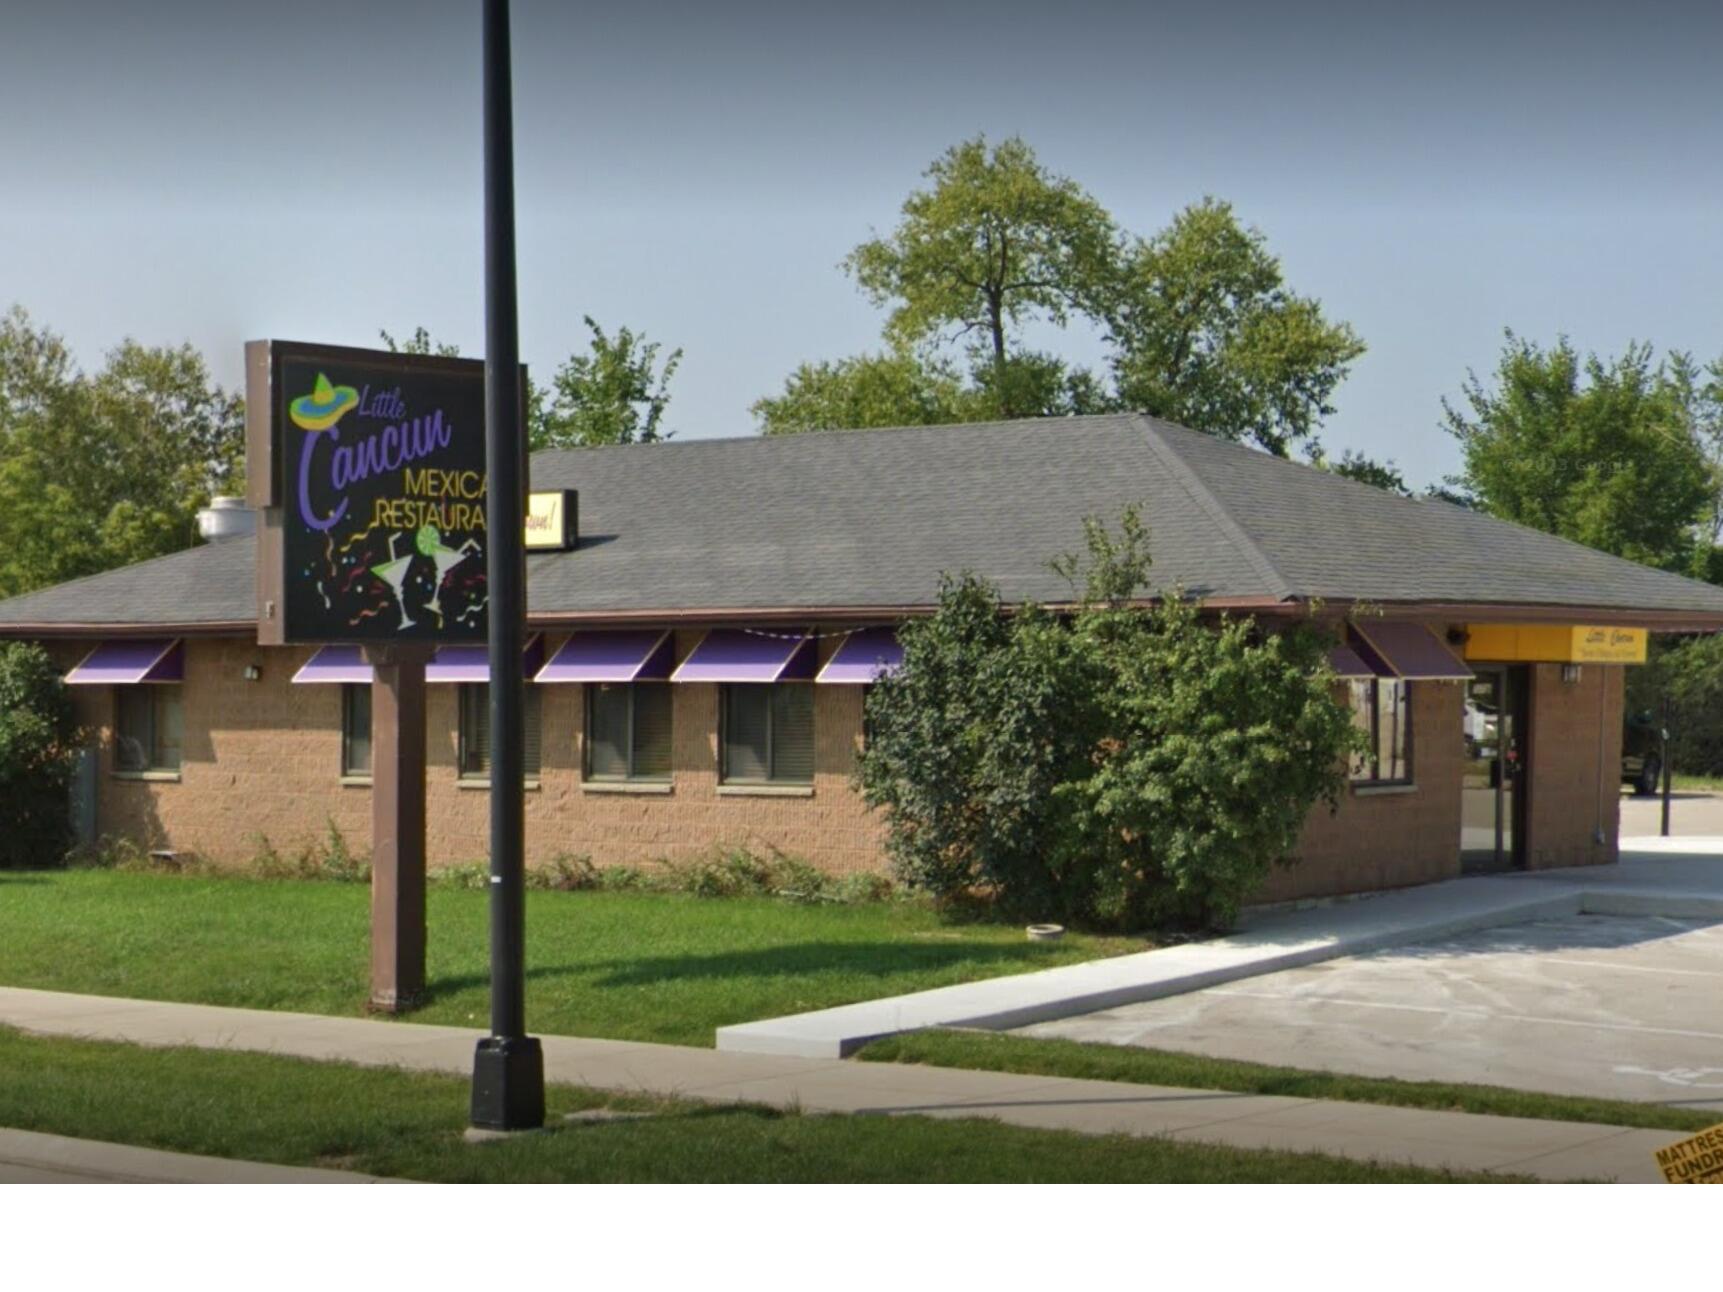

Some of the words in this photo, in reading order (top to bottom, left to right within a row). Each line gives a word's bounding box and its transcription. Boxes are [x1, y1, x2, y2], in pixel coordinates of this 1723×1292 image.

[358, 384, 407, 418] Little
[298, 409, 452, 530] Cancun
[404, 467, 488, 498] MEXICA
[374, 497, 487, 531] RESTAURA
